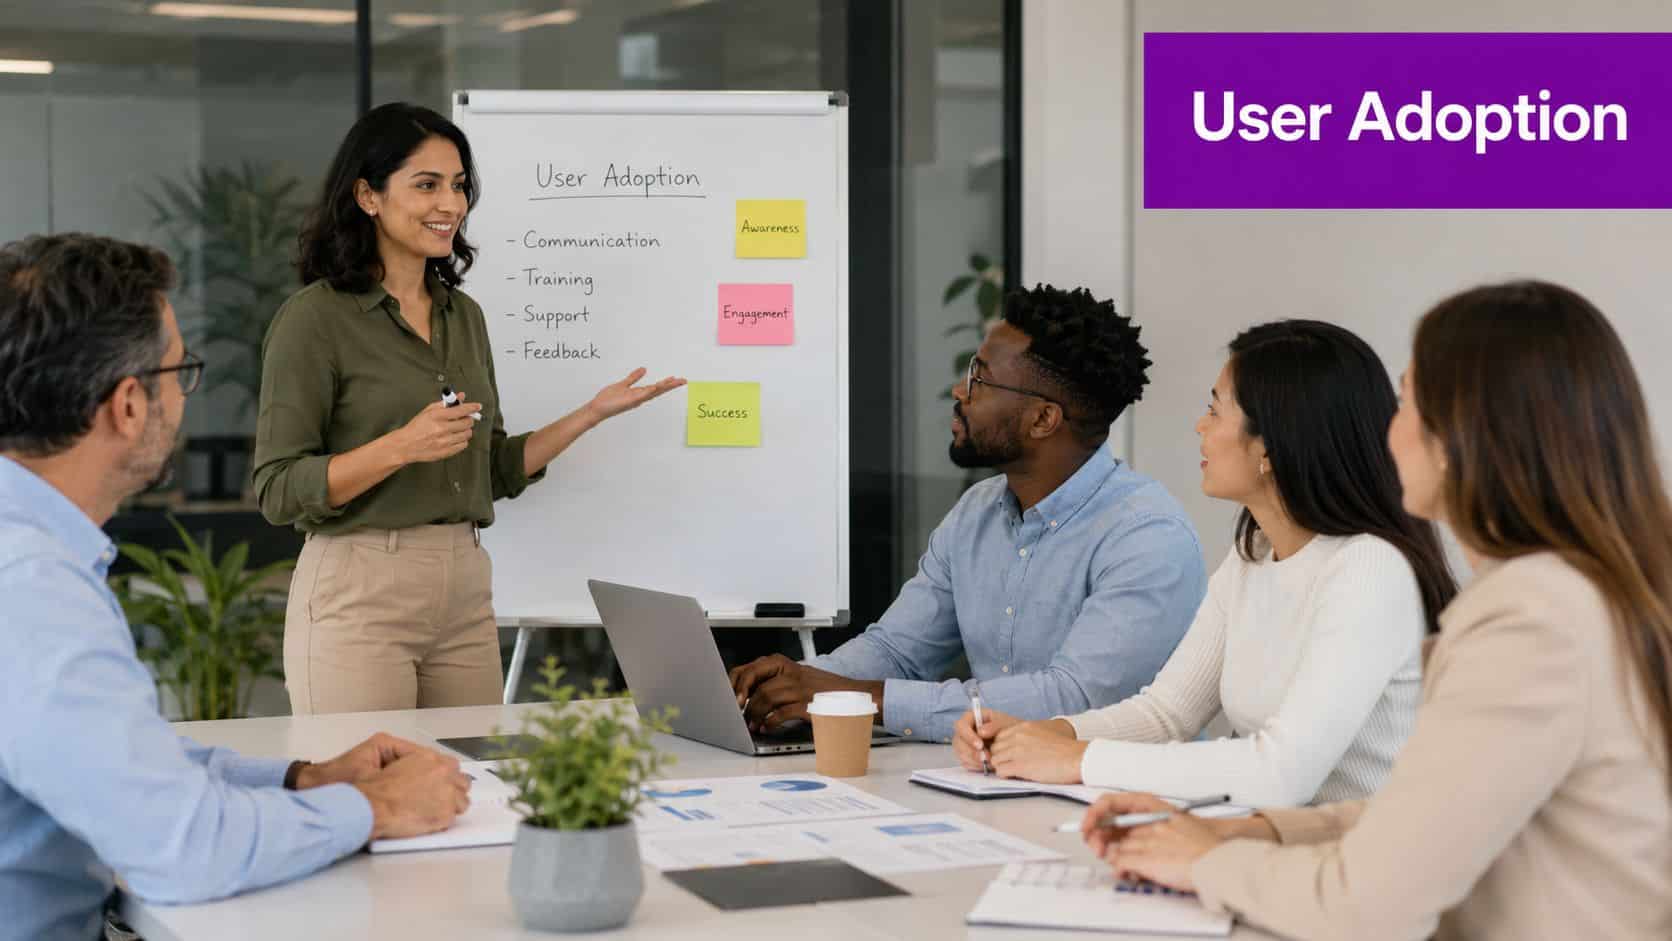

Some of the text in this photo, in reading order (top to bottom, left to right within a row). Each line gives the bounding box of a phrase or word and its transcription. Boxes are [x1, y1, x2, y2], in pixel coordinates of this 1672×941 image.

[535, 162, 701, 198] User Adoption
[740, 219, 801, 234] Awareness
[522, 229, 662, 249] Communication
[522, 267, 594, 296] Training
[522, 304, 591, 329] Support
[722, 303, 790, 326] Engagement
[523, 340, 602, 361] Feedback
[696, 402, 749, 420] Success
